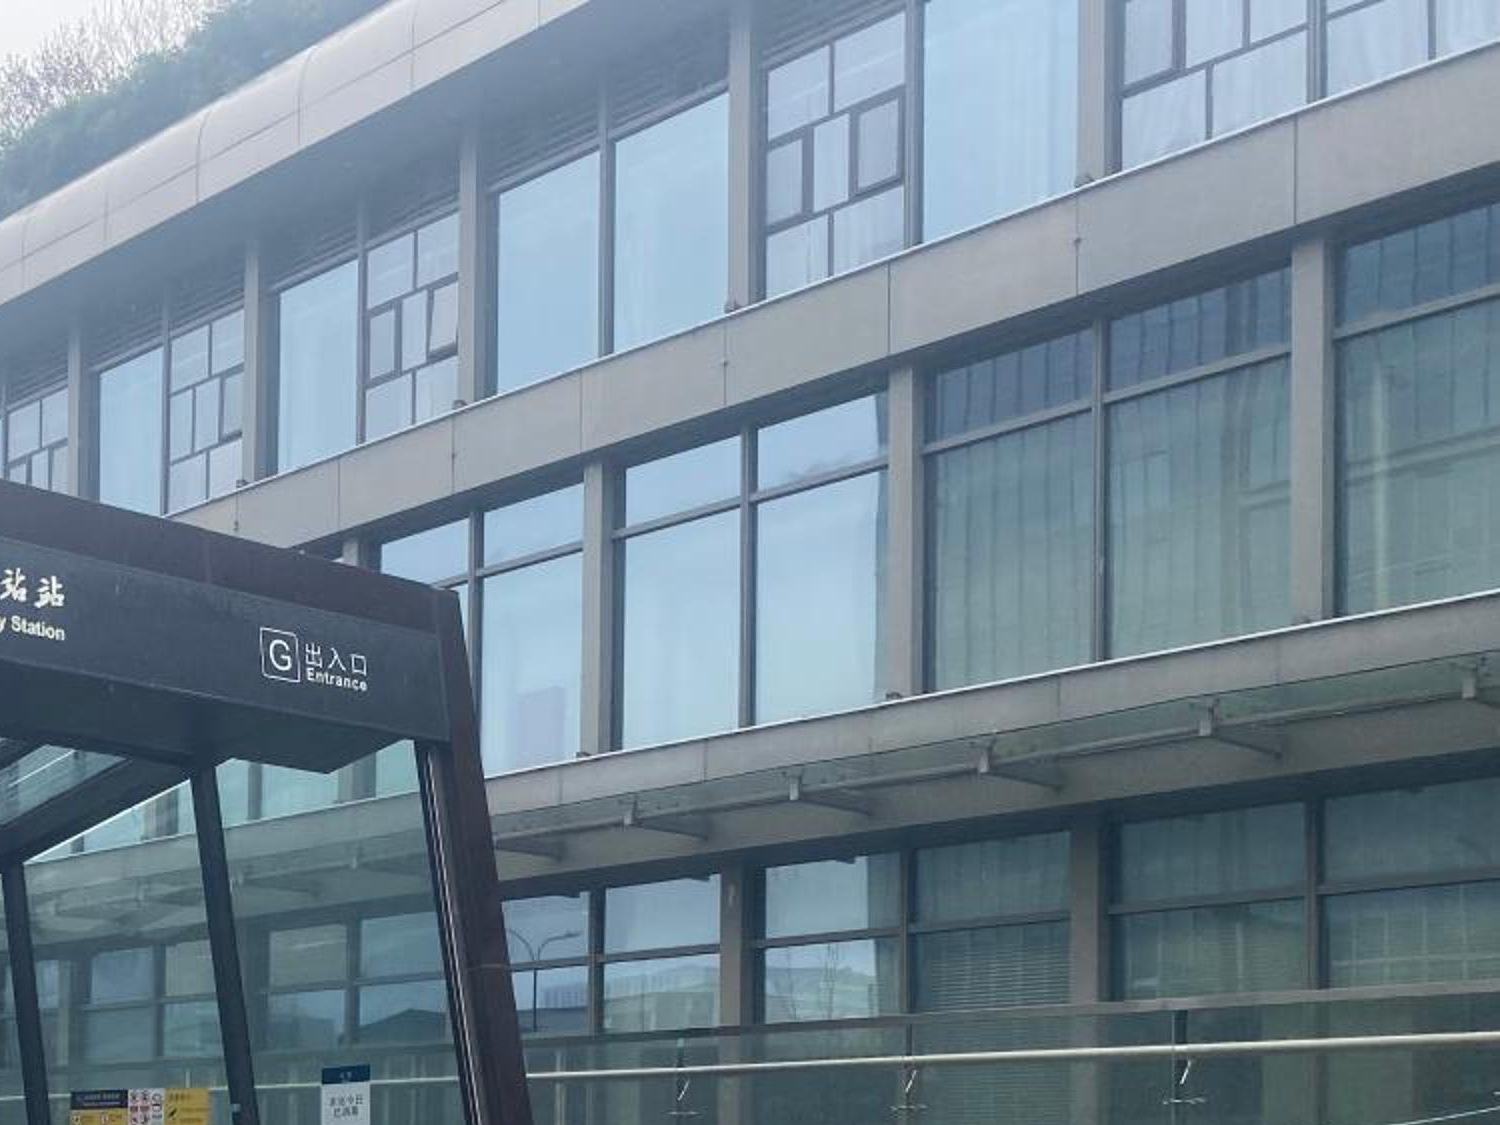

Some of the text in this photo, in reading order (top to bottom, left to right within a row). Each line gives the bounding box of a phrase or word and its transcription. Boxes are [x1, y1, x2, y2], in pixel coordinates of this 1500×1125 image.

[11, 614, 66, 641] Station
[269, 639, 292, 671] G
[305, 642, 367, 676] 出入口
[306, 667, 368, 692] Entrance
